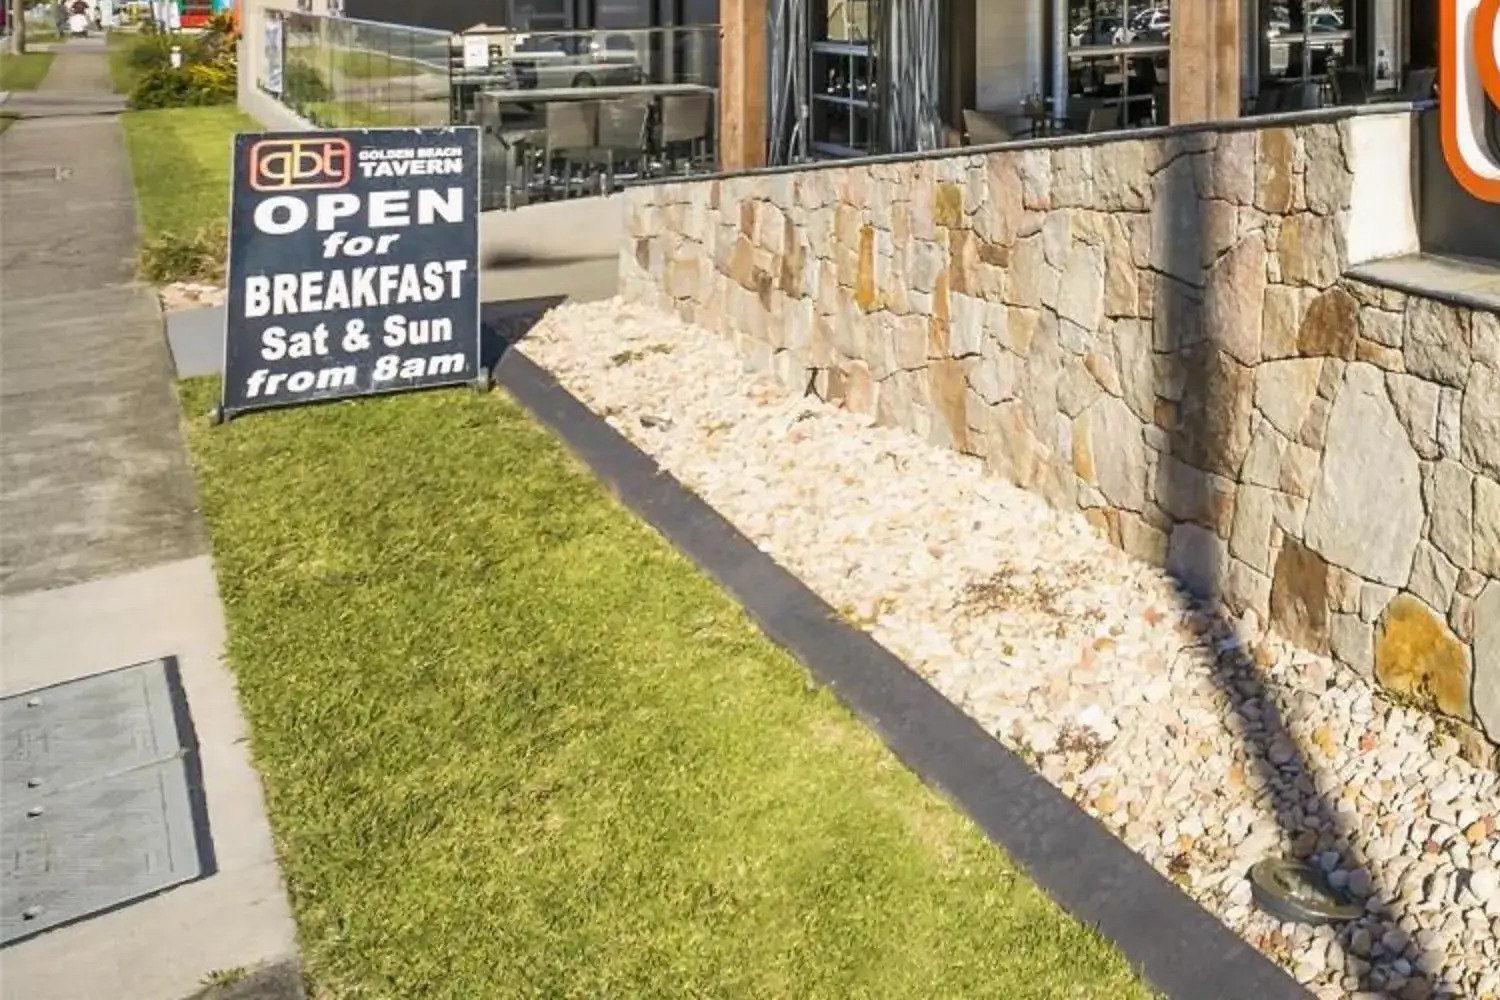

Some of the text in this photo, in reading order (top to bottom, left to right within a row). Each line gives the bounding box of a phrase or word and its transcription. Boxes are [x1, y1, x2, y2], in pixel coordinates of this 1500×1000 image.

[358, 146, 463, 161] GOLDEN BEACH
[358, 158, 463, 178] TAVERN
[253, 187, 464, 235] OPEN
[323, 231, 401, 259] for
[244, 259, 468, 318] BREAKFAST
[261, 314, 452, 361] Sat & Sun
[246, 353, 466, 398] from 8am
